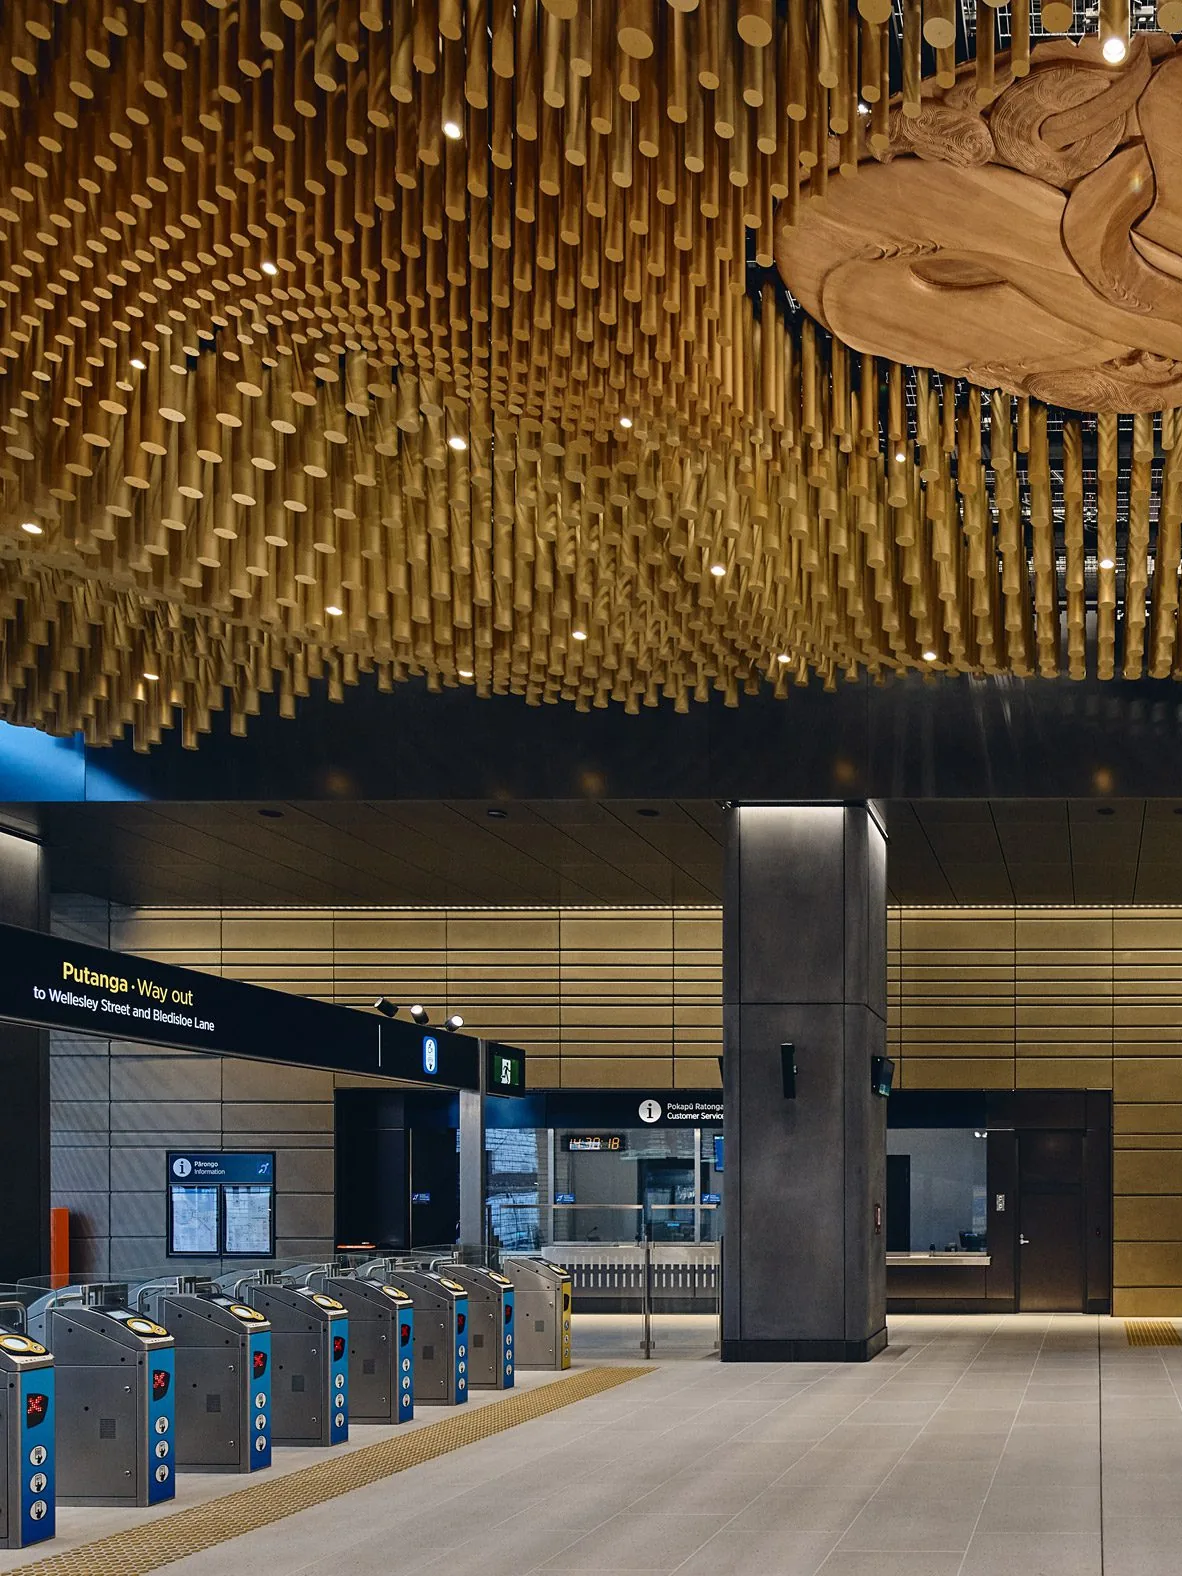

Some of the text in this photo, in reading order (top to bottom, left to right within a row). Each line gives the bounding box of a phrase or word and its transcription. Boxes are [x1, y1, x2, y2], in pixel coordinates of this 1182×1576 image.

[63, 961, 194, 1006] Putanga Way out
[33, 985, 215, 1032] to Wellesley Street and Bledisloe Lane
[667, 1111, 700, 1120] Customer
